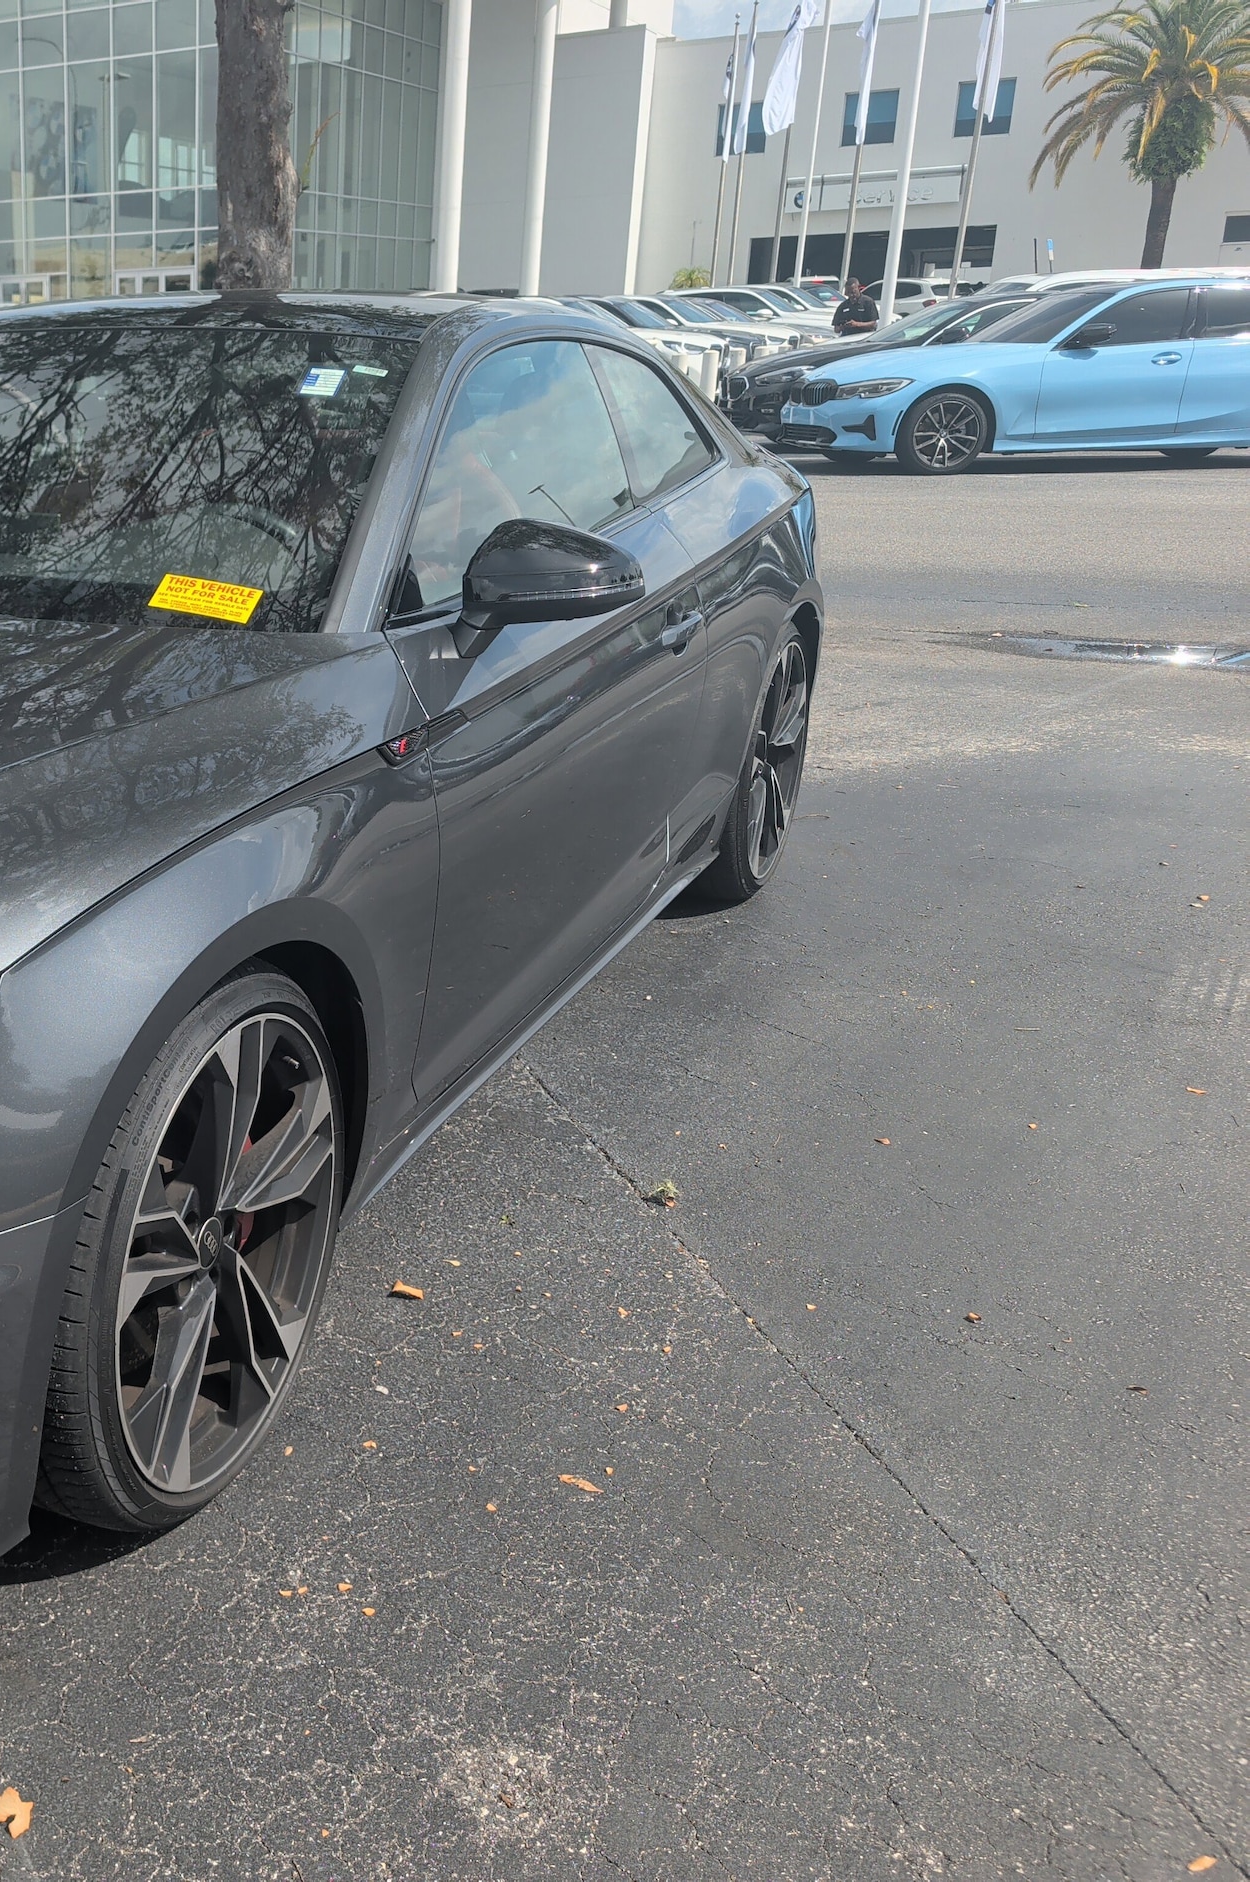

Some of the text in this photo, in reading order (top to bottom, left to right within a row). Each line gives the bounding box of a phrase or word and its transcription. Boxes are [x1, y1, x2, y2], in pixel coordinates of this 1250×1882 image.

[848, 186, 934, 204] erce
[166, 585, 249, 606] NOT FOR SALE
[169, 576, 257, 599] THIS VEHICLE
